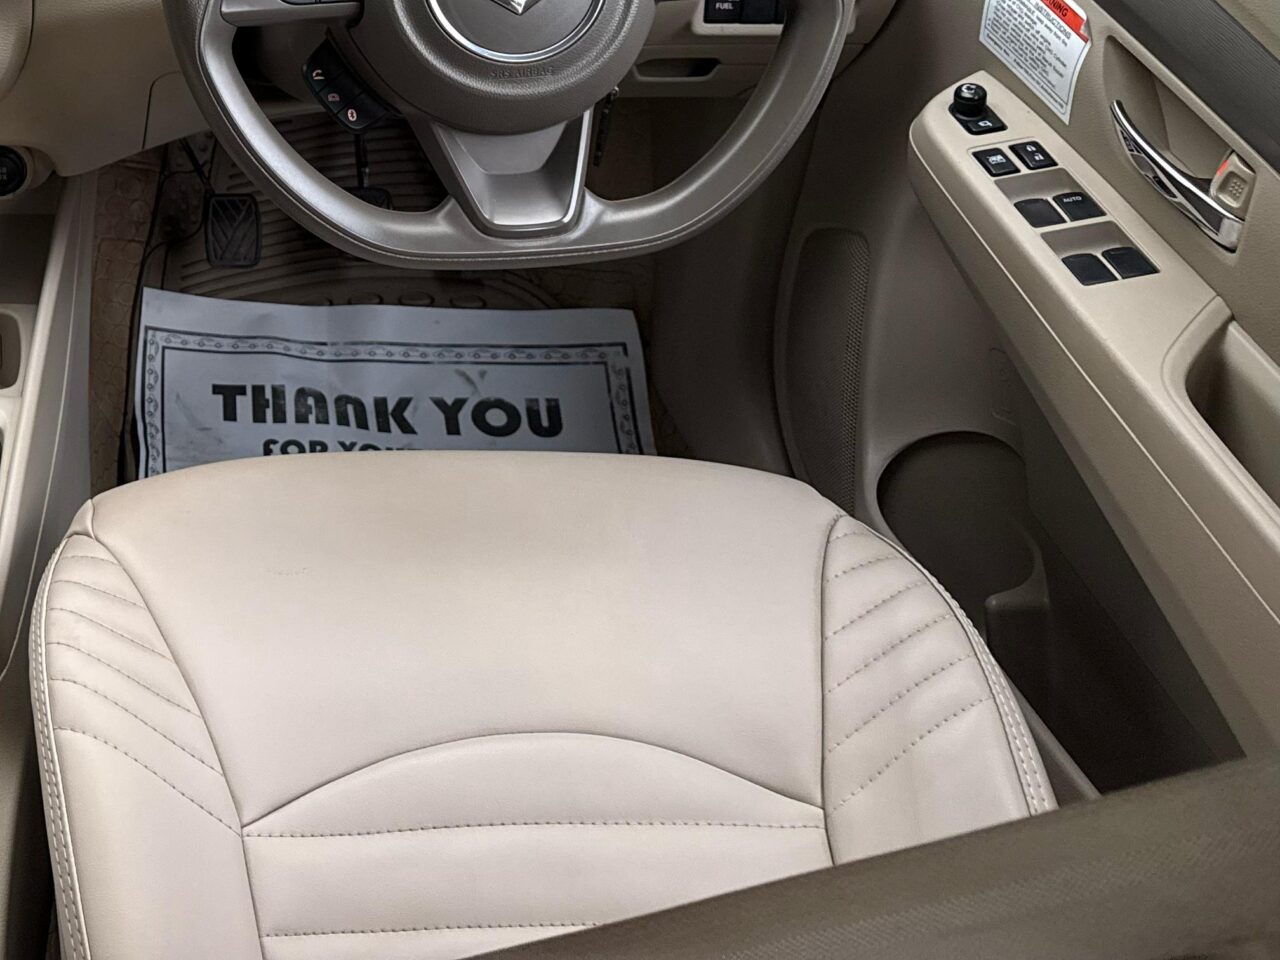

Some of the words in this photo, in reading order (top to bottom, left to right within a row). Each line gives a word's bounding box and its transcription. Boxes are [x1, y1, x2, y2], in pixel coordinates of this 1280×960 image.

[715, 2, 734, 10] FUEL
[1063, 195, 1082, 203] AUTO
[211, 383, 418, 435] THANK
[430, 397, 564, 438] YOU
